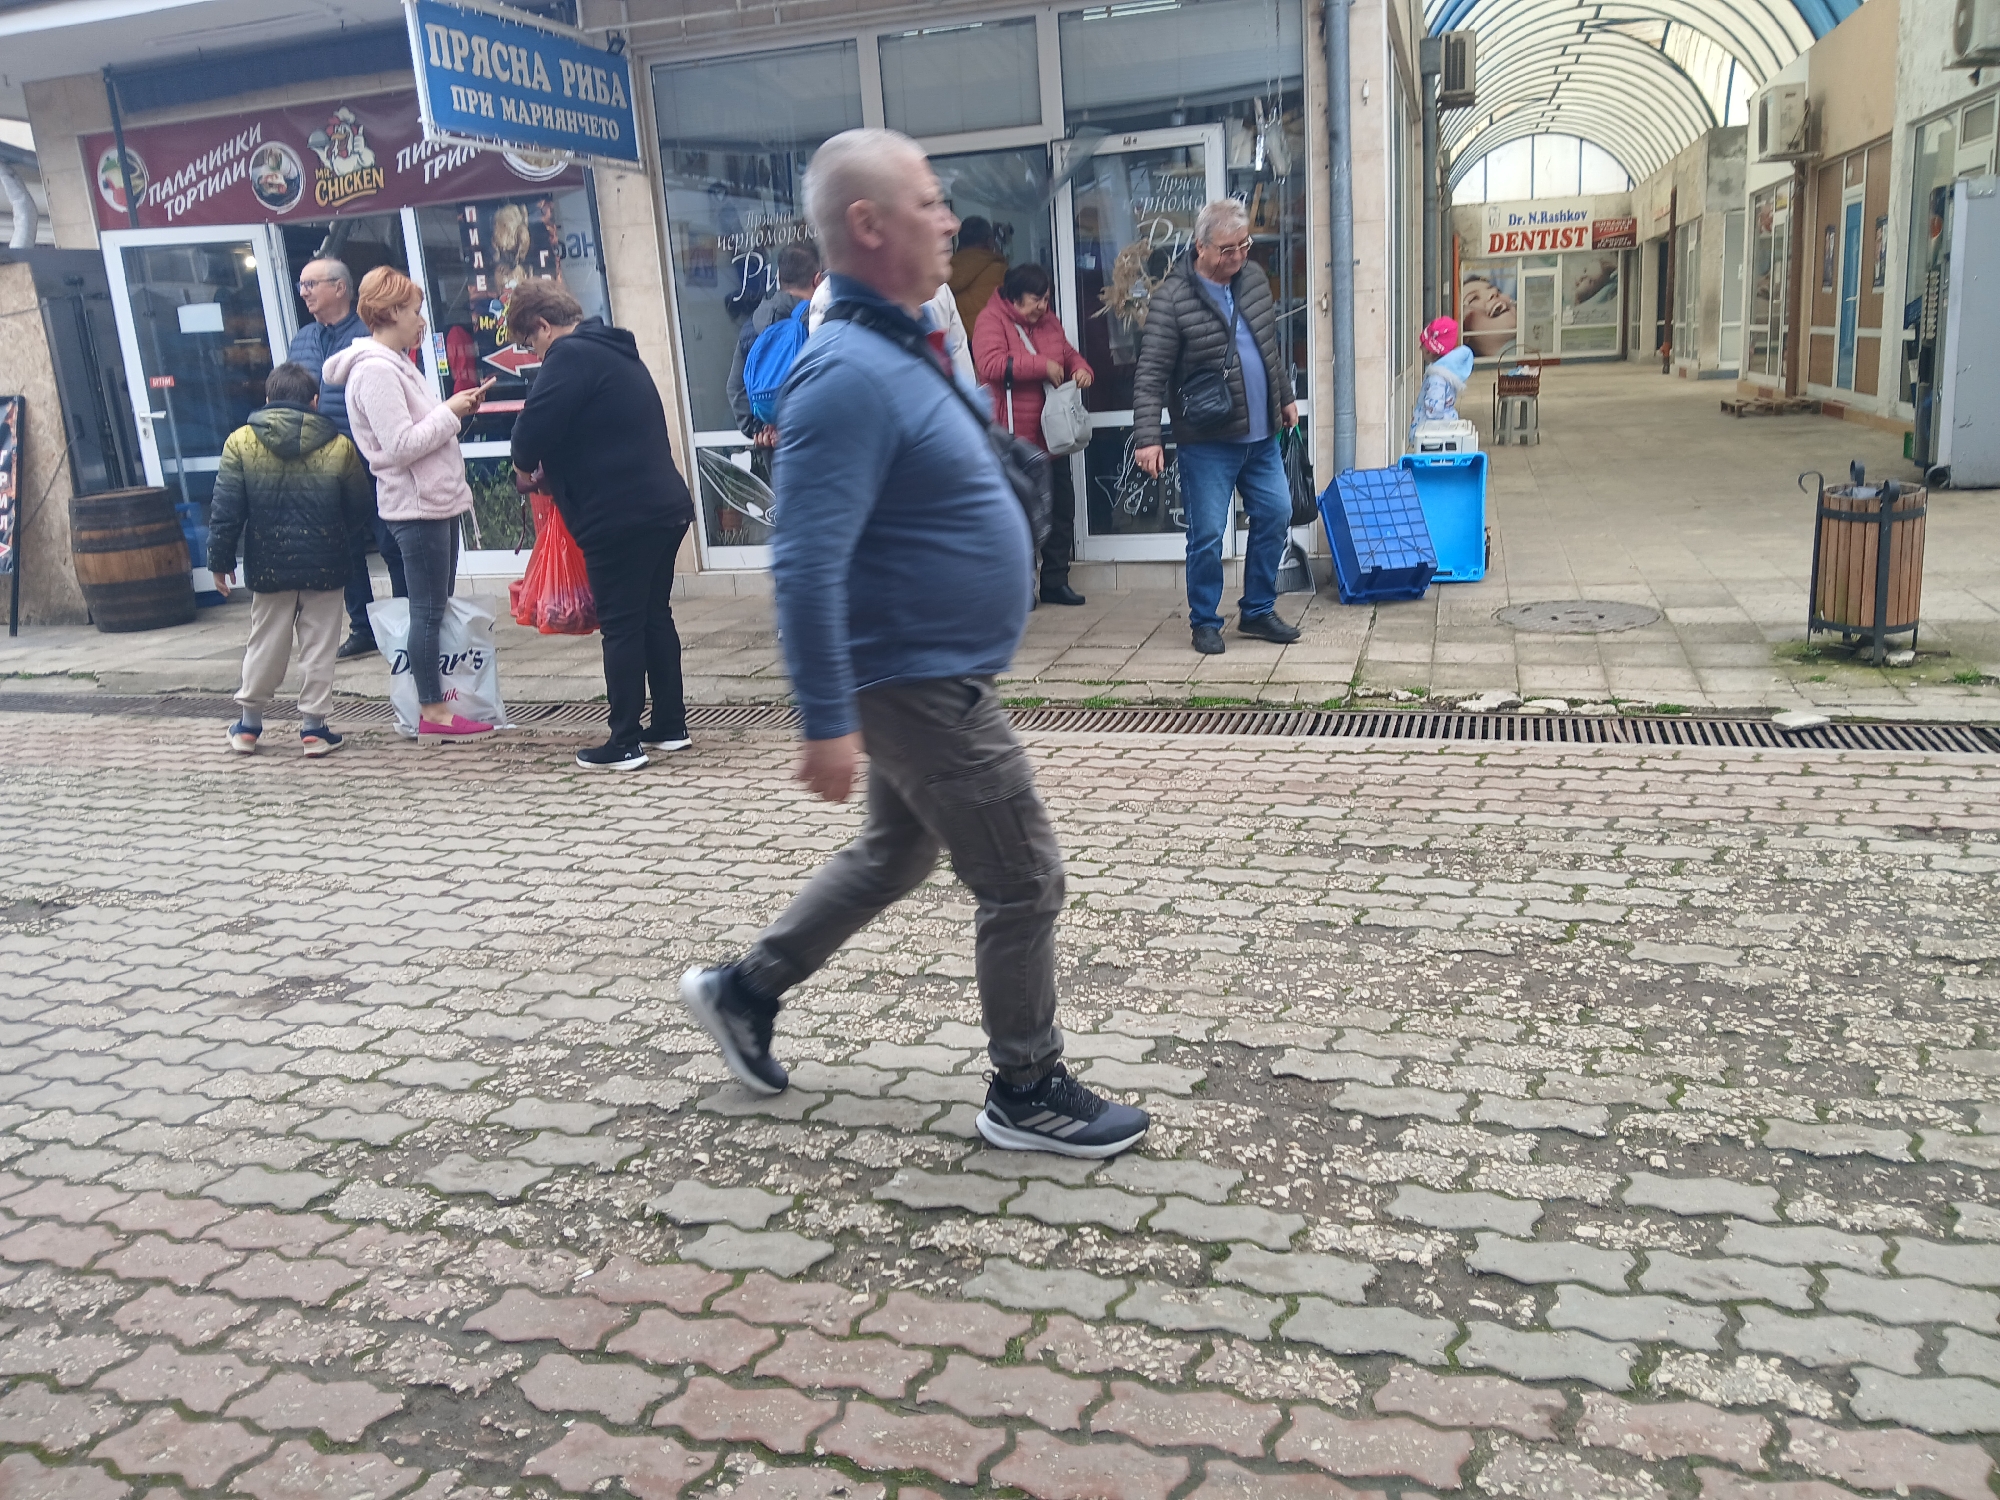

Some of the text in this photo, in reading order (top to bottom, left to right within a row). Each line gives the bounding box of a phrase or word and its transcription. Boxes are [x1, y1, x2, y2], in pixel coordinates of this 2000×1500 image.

[425, 22, 628, 109] ПРЯСНА РИБА
[450, 84, 620, 141] ПРИ МАРИЯНЧЕТО
[149, 122, 262, 206] ПАЛАЧИНКИ
[163, 157, 246, 222] ТОРТИЛИ
[315, 167, 384, 207] CHICKEN
[464, 205, 487, 292] ПИЛЕ
[1488, 226, 1588, 254] DENTIST
[1508, 213, 1526, 227] Dr.
[391, 647, 484, 676] Dar's
